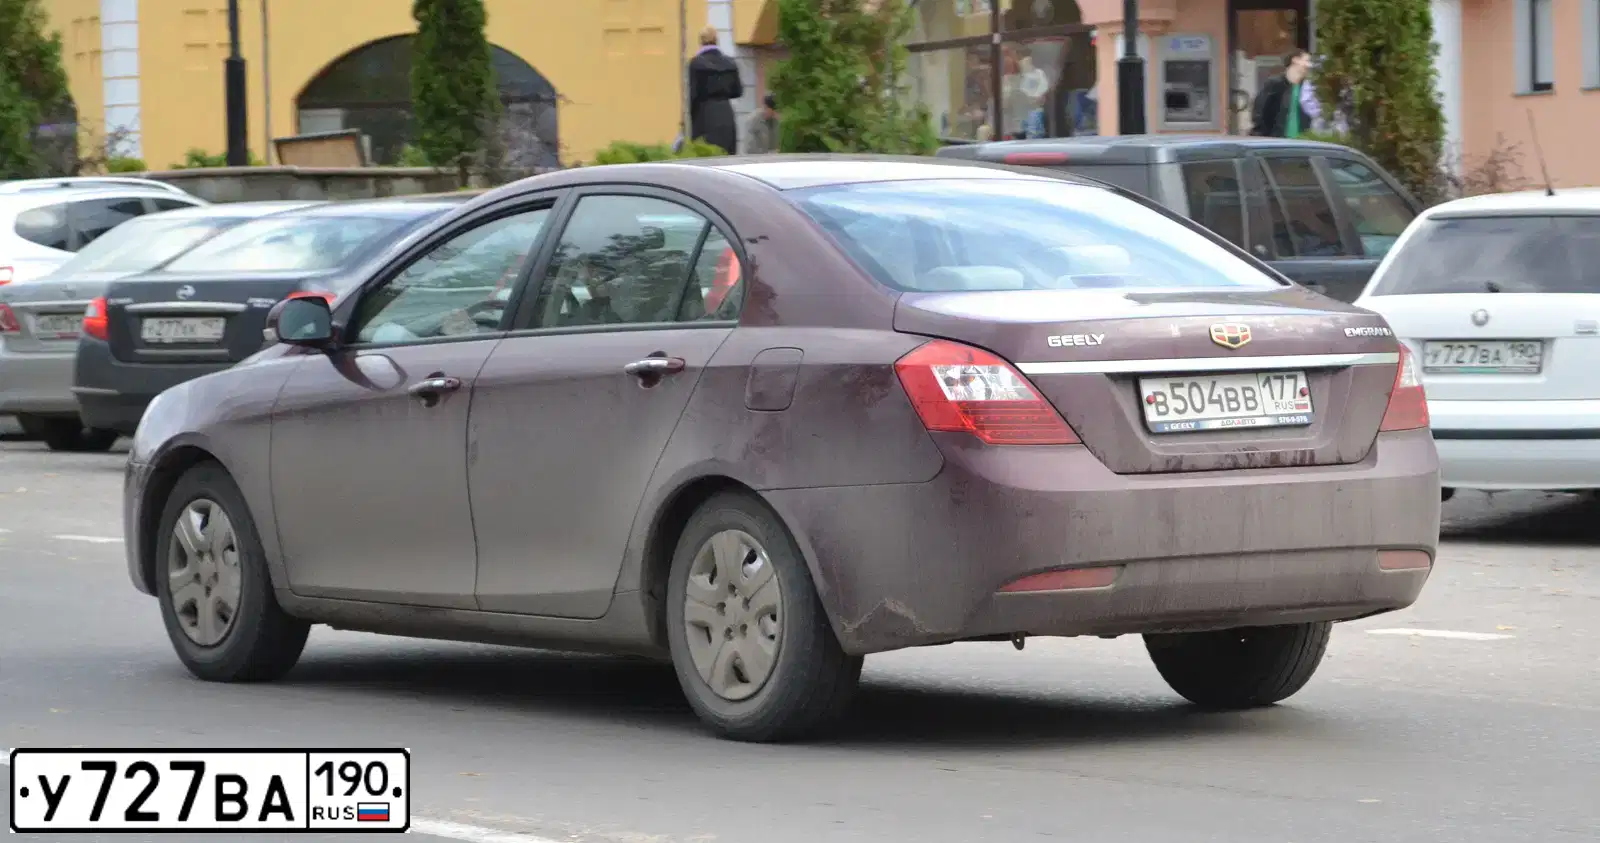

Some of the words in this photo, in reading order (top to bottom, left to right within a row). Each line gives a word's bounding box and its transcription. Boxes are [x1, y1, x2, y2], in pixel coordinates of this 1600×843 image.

[1047, 333, 1105, 347] GEELY
[1154, 381, 1258, 416] В504ВВ
[1262, 374, 1298, 400] 177
[1275, 401, 1294, 411] RUS
[1171, 421, 1195, 430] GEELY
